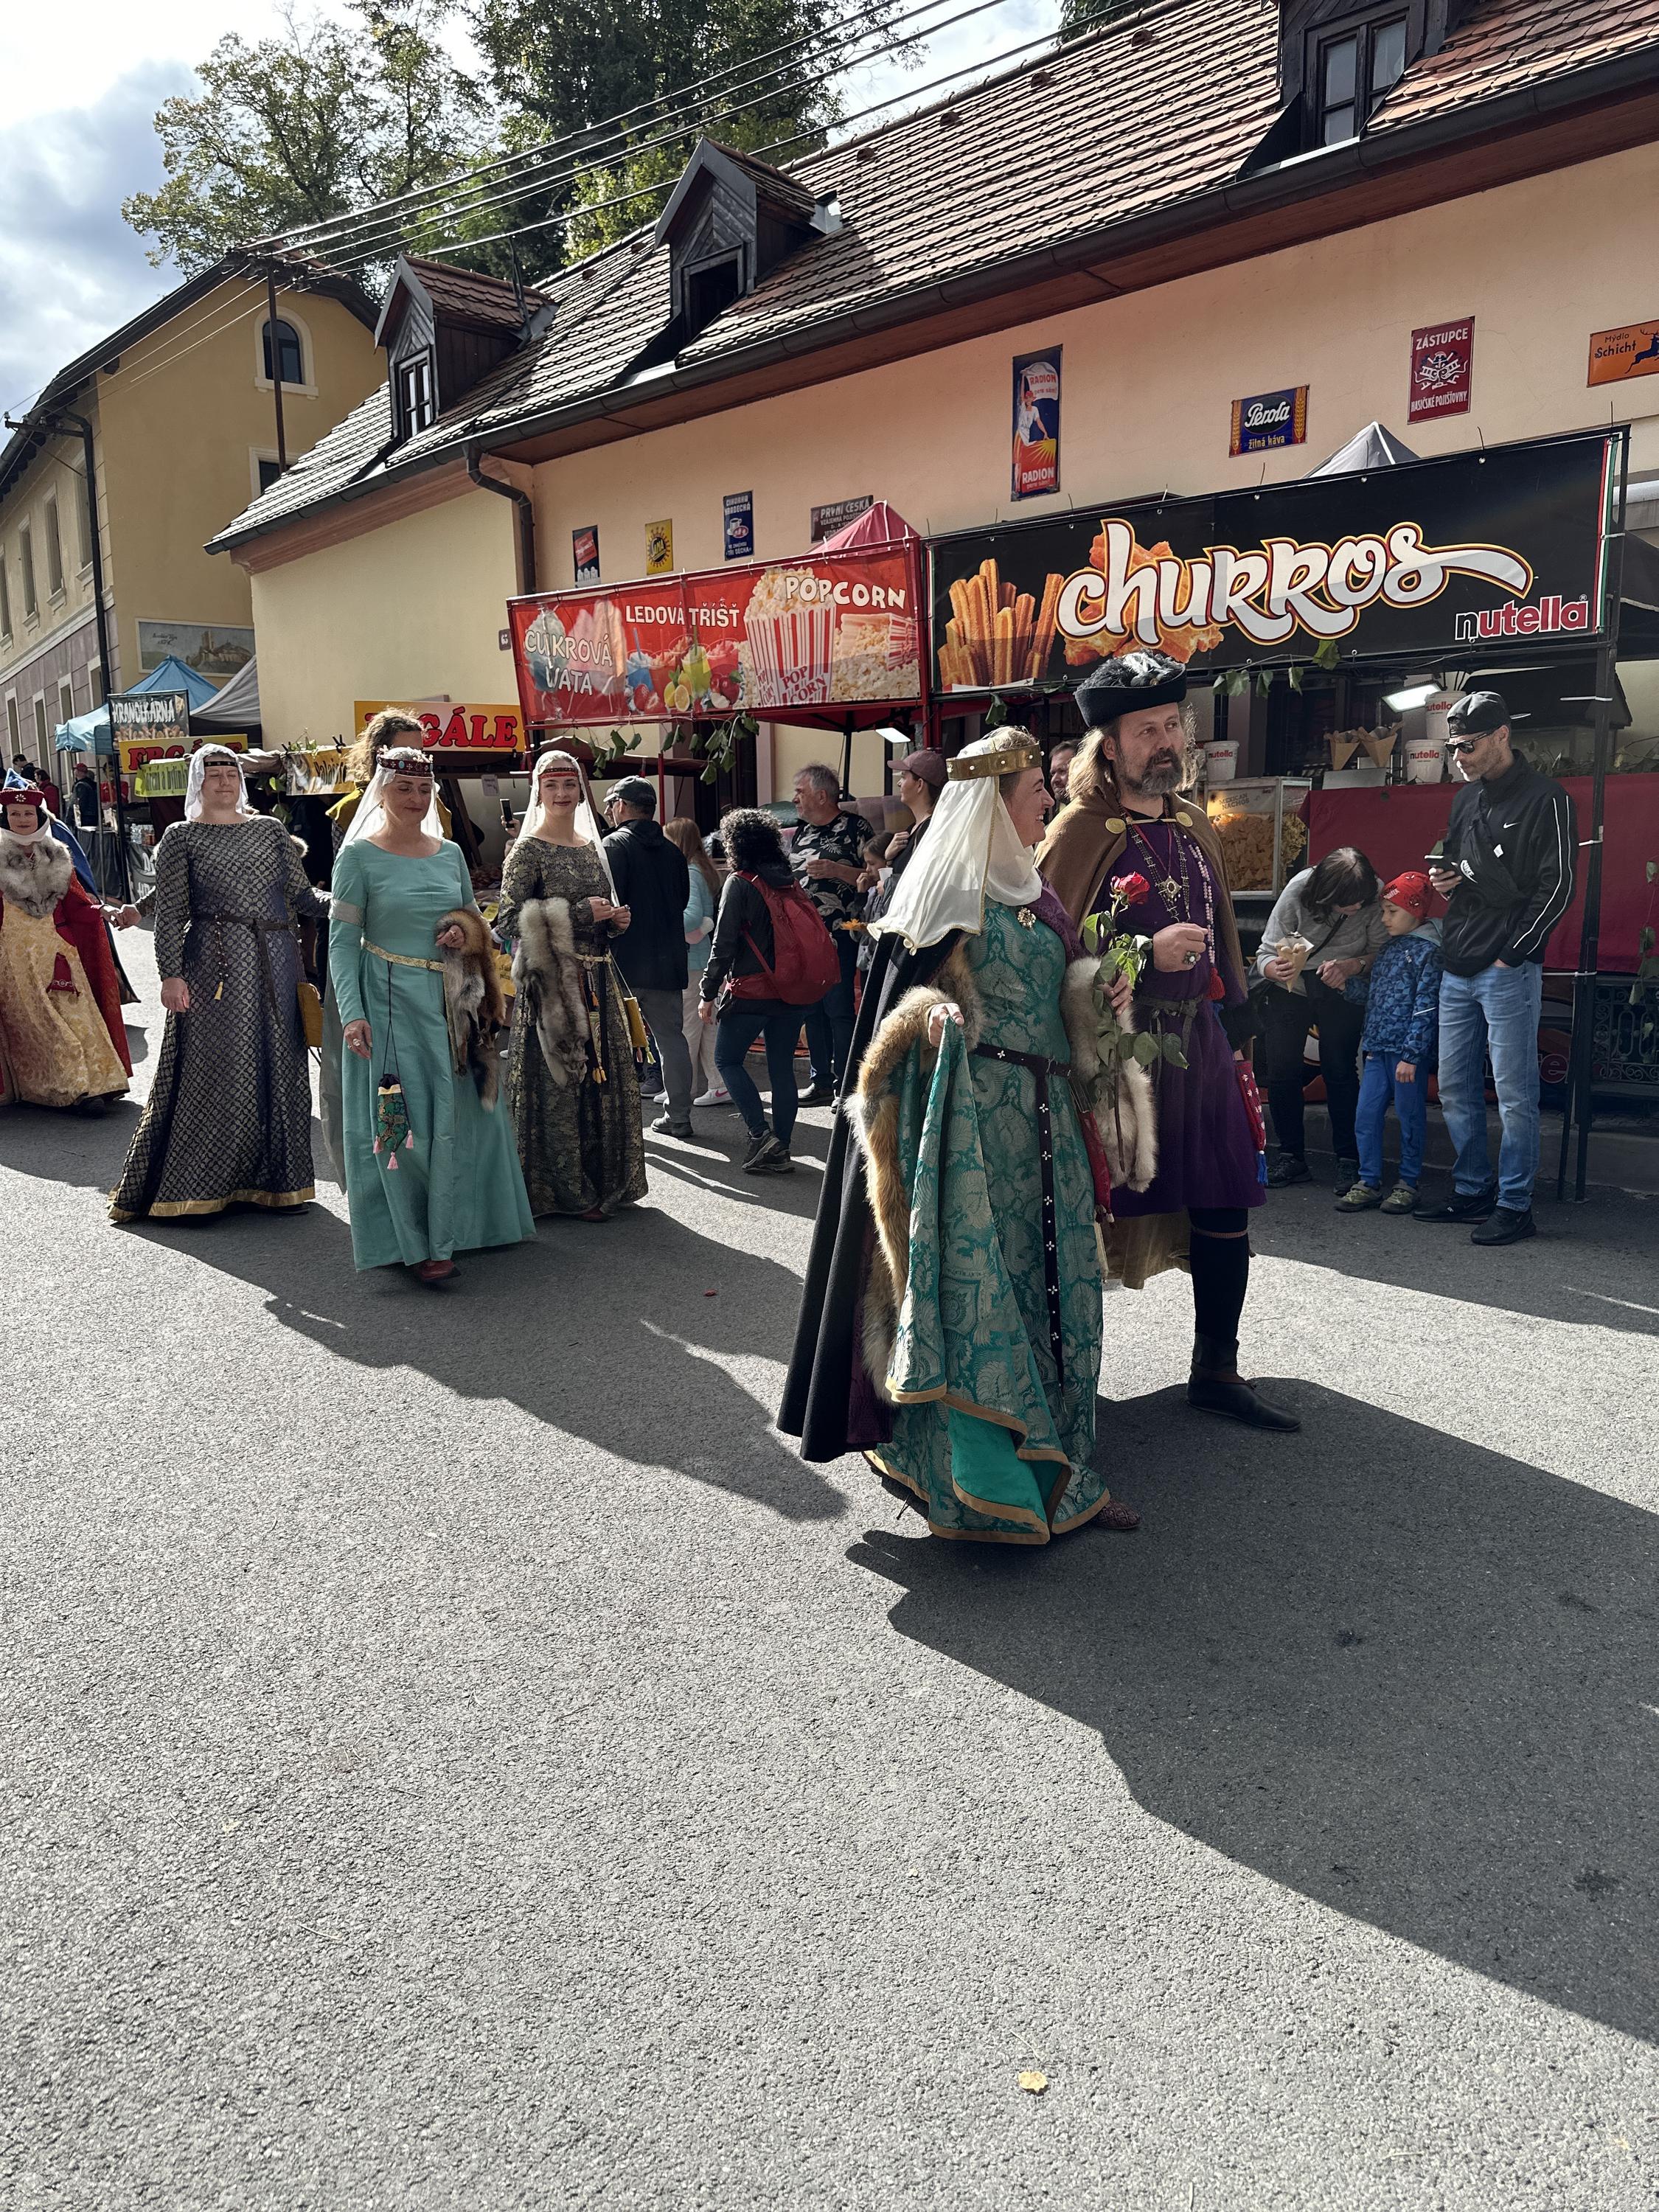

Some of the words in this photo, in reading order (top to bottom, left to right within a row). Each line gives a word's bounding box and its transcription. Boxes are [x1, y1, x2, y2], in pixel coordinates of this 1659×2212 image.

[1416, 327, 1468, 351] ZÁSTUPCE
[1604, 333, 1630, 343] Mýdlo
[1594, 340, 1636, 358] Schicht
[1029, 374, 1057, 385] RADION
[1411, 394, 1435, 412] HASIČSKÉ
[1244, 401, 1290, 428] Perola
[1248, 437, 1266, 449] žitná
[1268, 434, 1285, 445] káva
[1022, 466, 1054, 484] RADION
[821, 504, 844, 519] PRVNÍ
[846, 498, 870, 513] ČESKÁ
[785, 577, 906, 610] POPCORN
[625, 601, 685, 625] LEDOVÁ
[689, 602, 740, 627] TŘÍŠŤ
[524, 630, 613, 667] CUKROVÁ
[782, 666, 807, 690] POP
[1208, 749, 1233, 759] nutella
[1410, 750, 1439, 759] nutella
[1219, 793, 1248, 804] MEXICAN
[1222, 798, 1250, 810] NACHOS
[1463, 860, 1475, 877] NIKE
